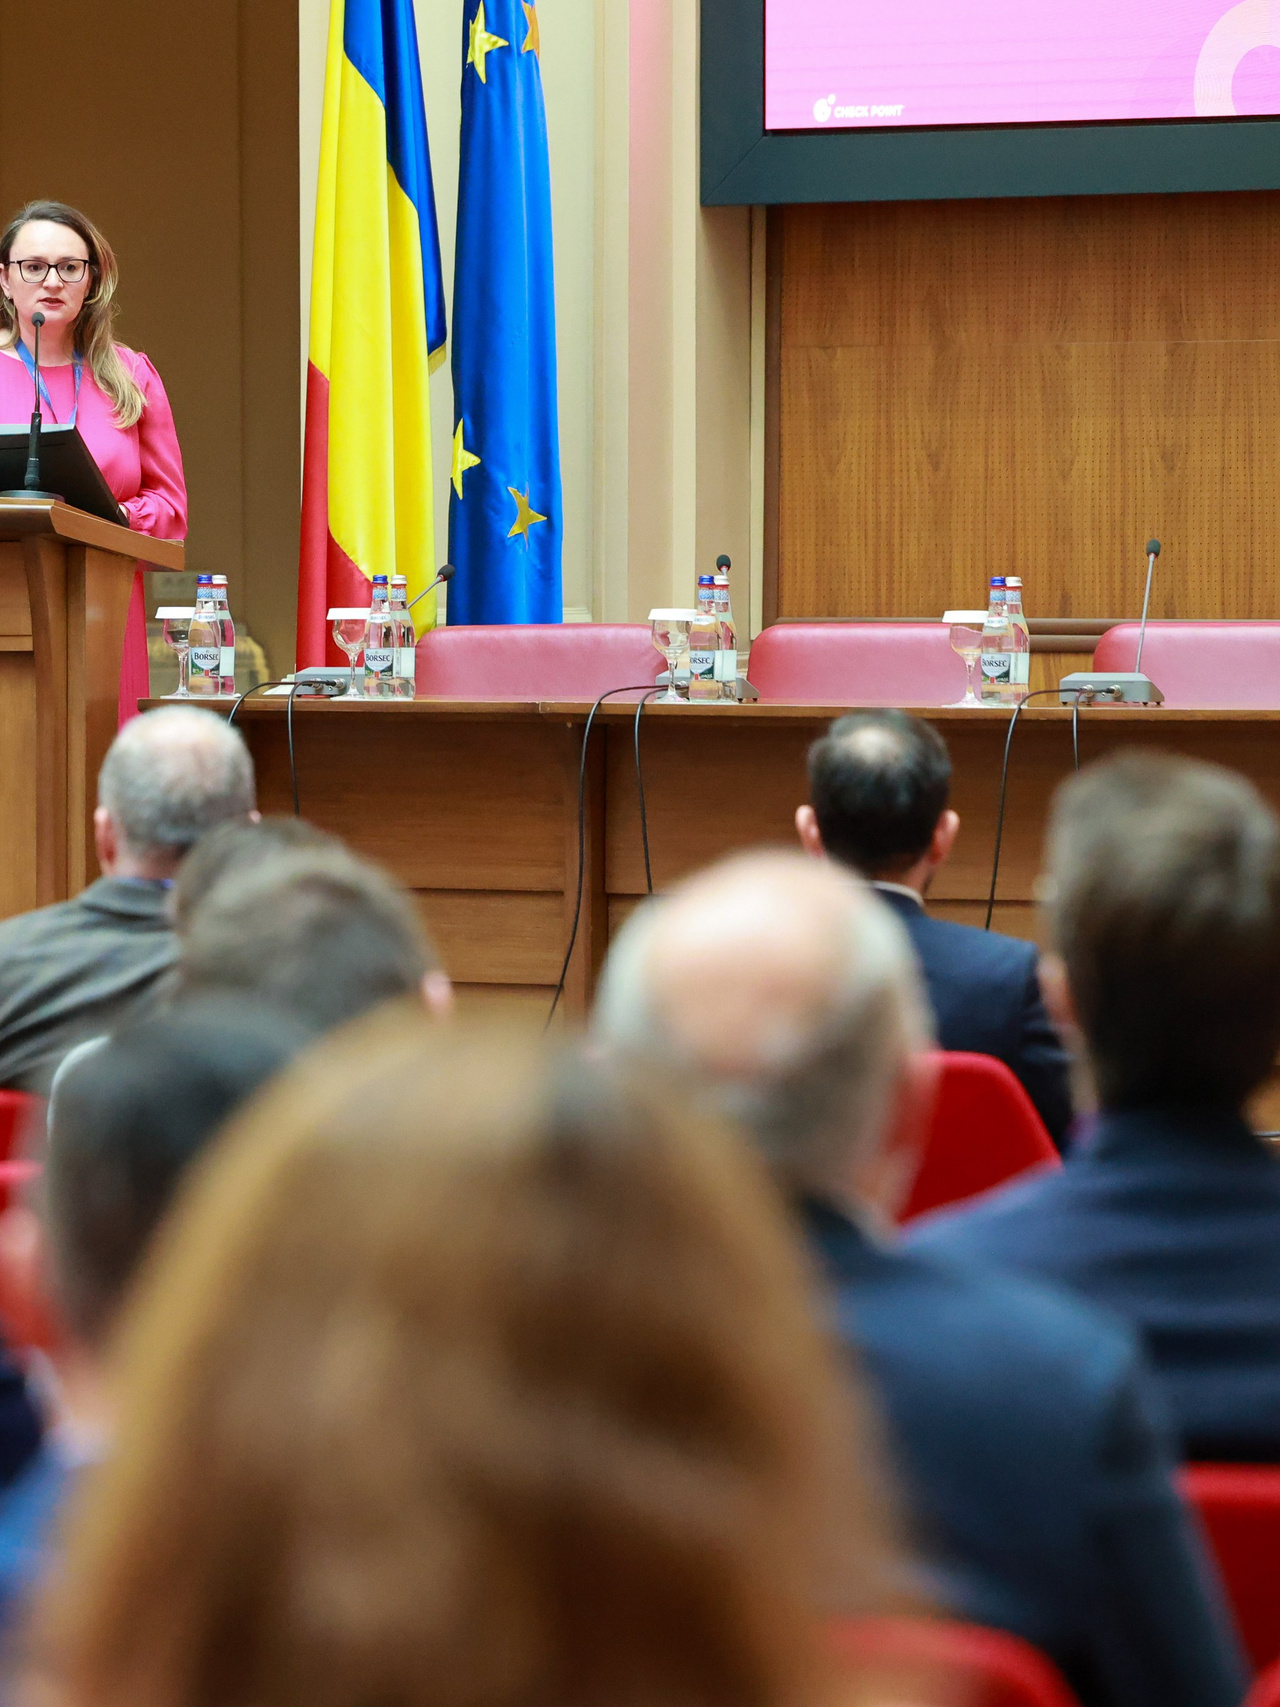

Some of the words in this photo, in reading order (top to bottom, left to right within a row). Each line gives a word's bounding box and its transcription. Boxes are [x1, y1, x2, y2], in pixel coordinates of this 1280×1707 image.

[834, 106, 869, 118] CHECK
[871, 105, 904, 117] POINT
[194, 652, 219, 661] BORSEC
[365, 653, 390, 662] BORSEC
[690, 656, 711, 665] ORSEC
